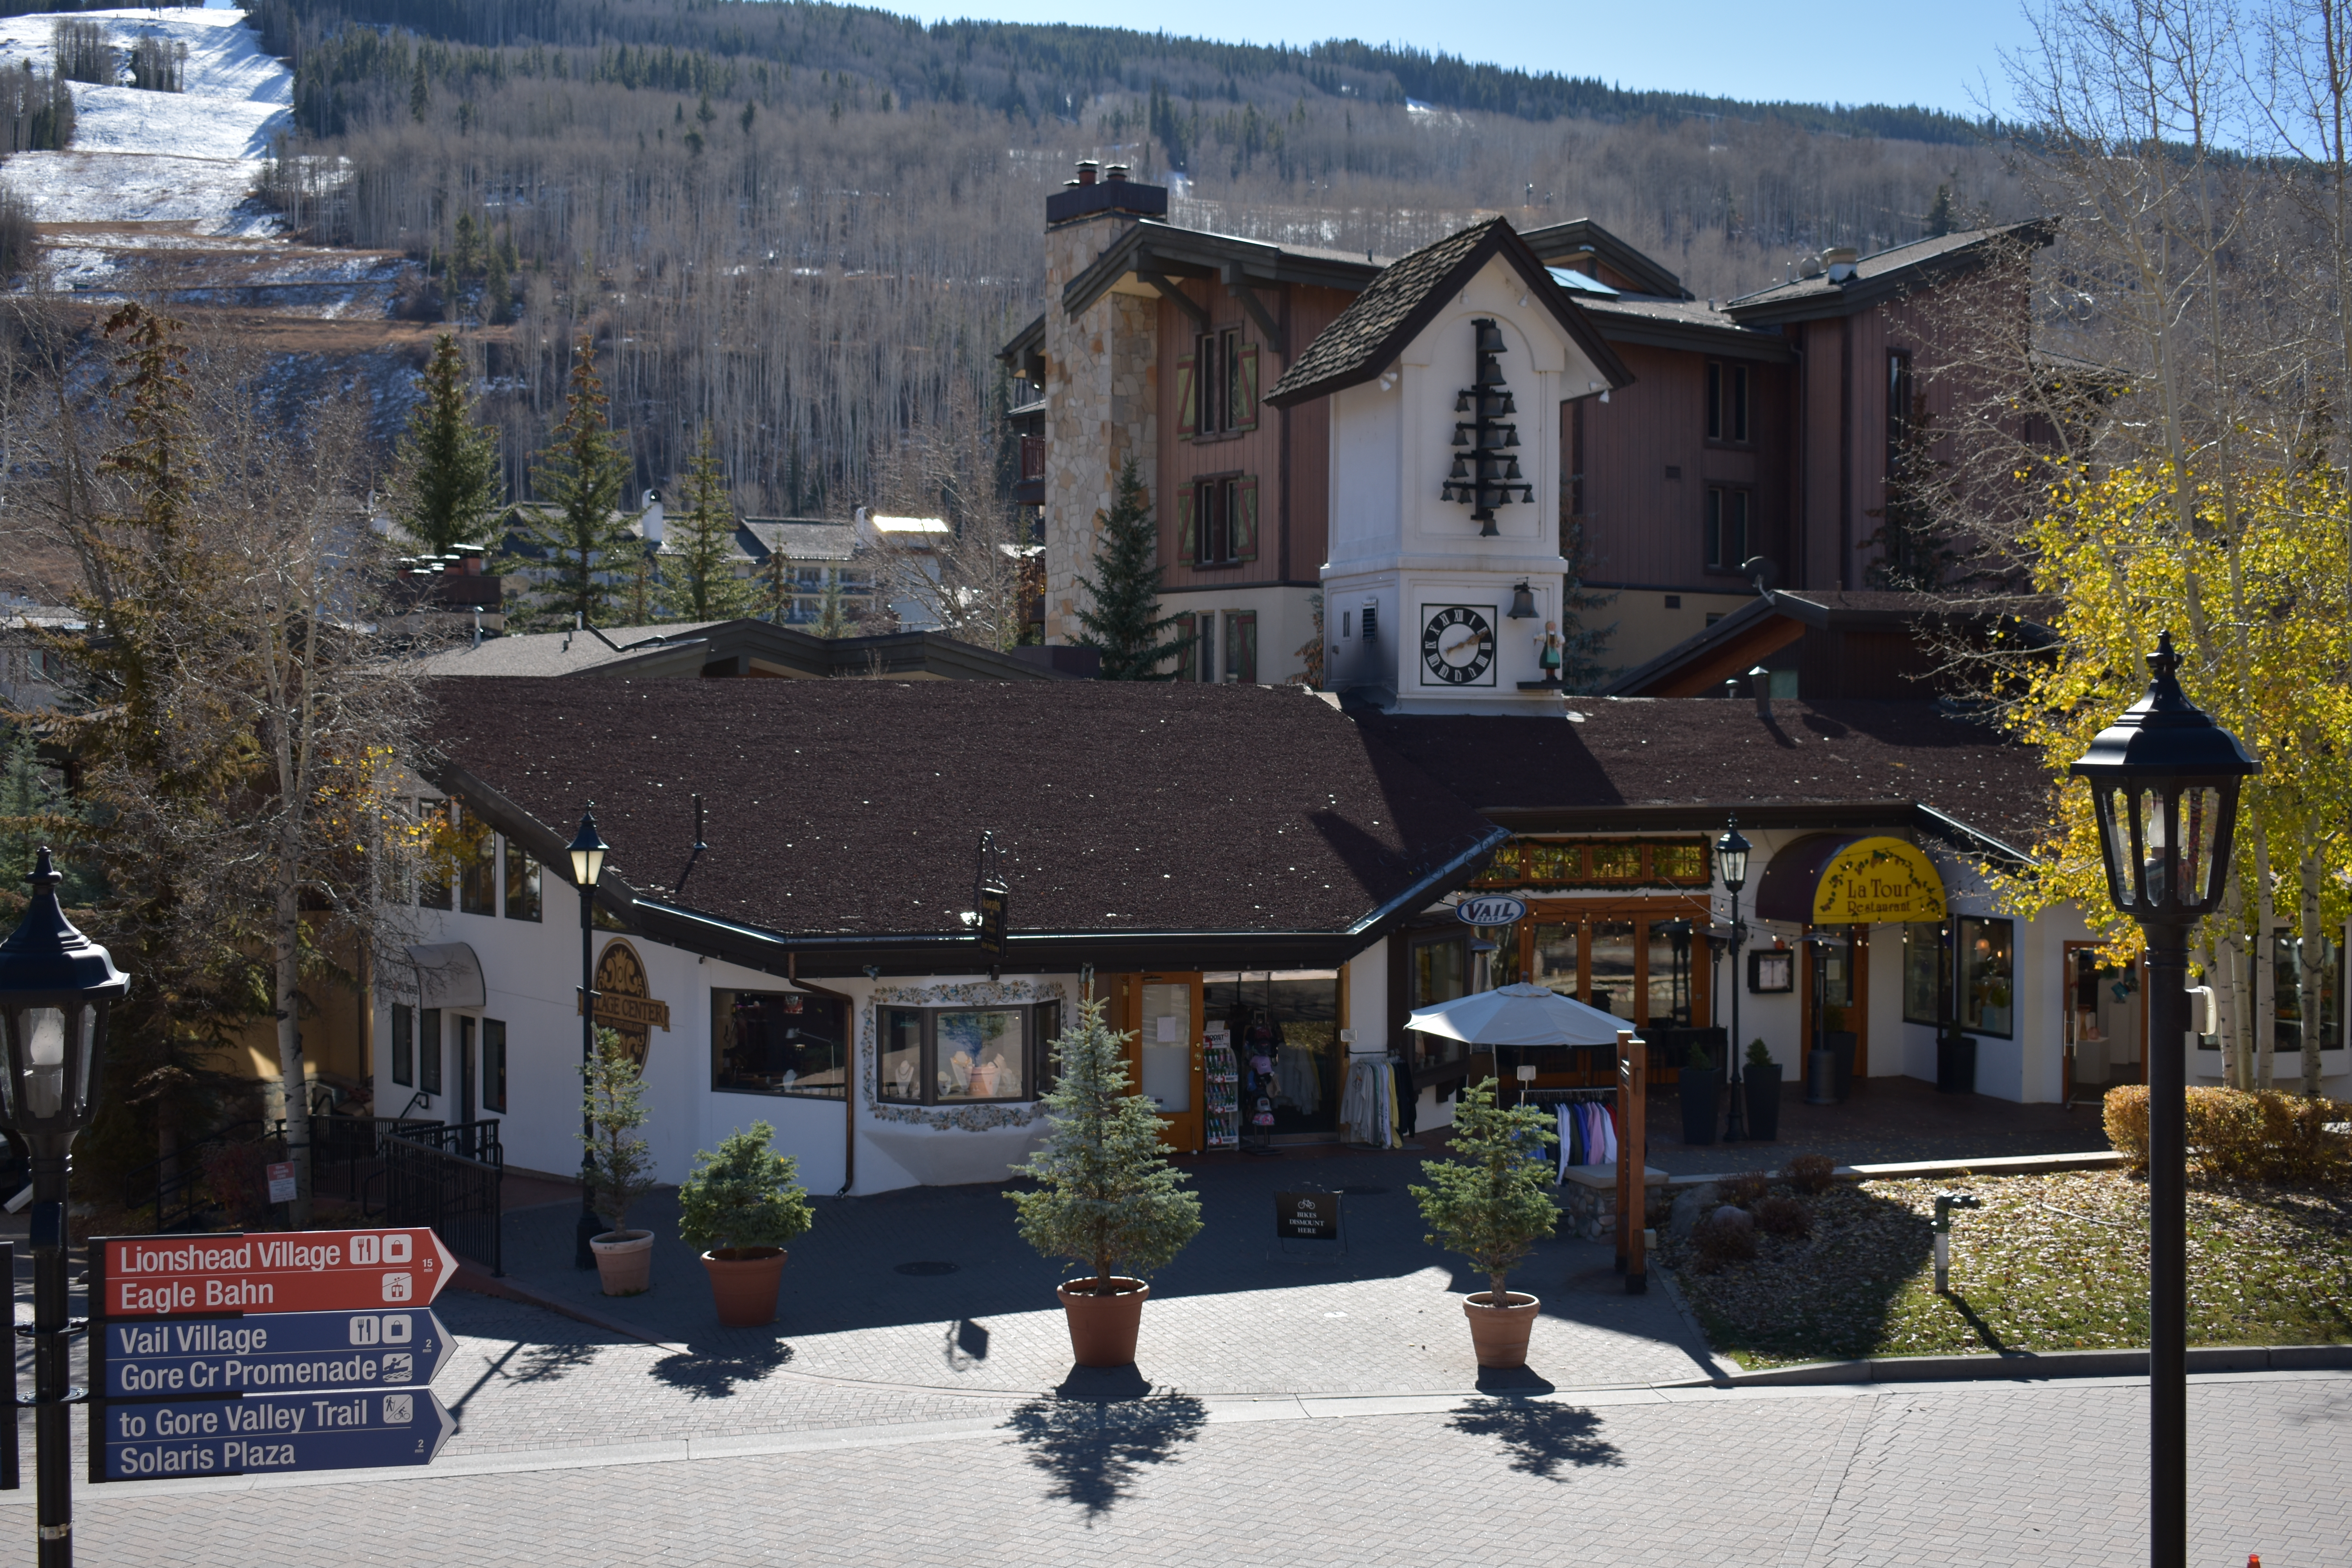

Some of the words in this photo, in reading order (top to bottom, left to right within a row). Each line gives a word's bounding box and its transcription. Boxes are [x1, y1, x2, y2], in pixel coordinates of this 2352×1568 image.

[1847, 879, 1867, 898] La
[1870, 878, 1912, 898] Tour
[1466, 903, 1514, 920] VAIL
[1847, 900, 1912, 913] Restaurant
[592, 995, 619, 1015] LAGE
[622, 999, 664, 1024] CENTER
[122, 1243, 251, 1272] Lionshead
[258, 1241, 341, 1272] Village
[423, 1259, 433, 1267] 15
[122, 1281, 196, 1314] Eagle
[206, 1279, 274, 1306] Bahn
[120, 1327, 168, 1354] Vail
[177, 1325, 267, 1355] Village
[426, 1339, 432, 1347] 2
[121, 1364, 183, 1390] Gore
[190, 1361, 219, 1387] Cr
[225, 1355, 377, 1386] Promenade
[120, 1412, 146, 1437] to
[156, 1409, 218, 1435] Gore
[225, 1403, 305, 1434] Valley
[312, 1399, 367, 1427] Trail
[121, 1444, 214, 1474] Solaris
[224, 1441, 296, 1467] Plaza
[418, 1439, 424, 1448] 2
